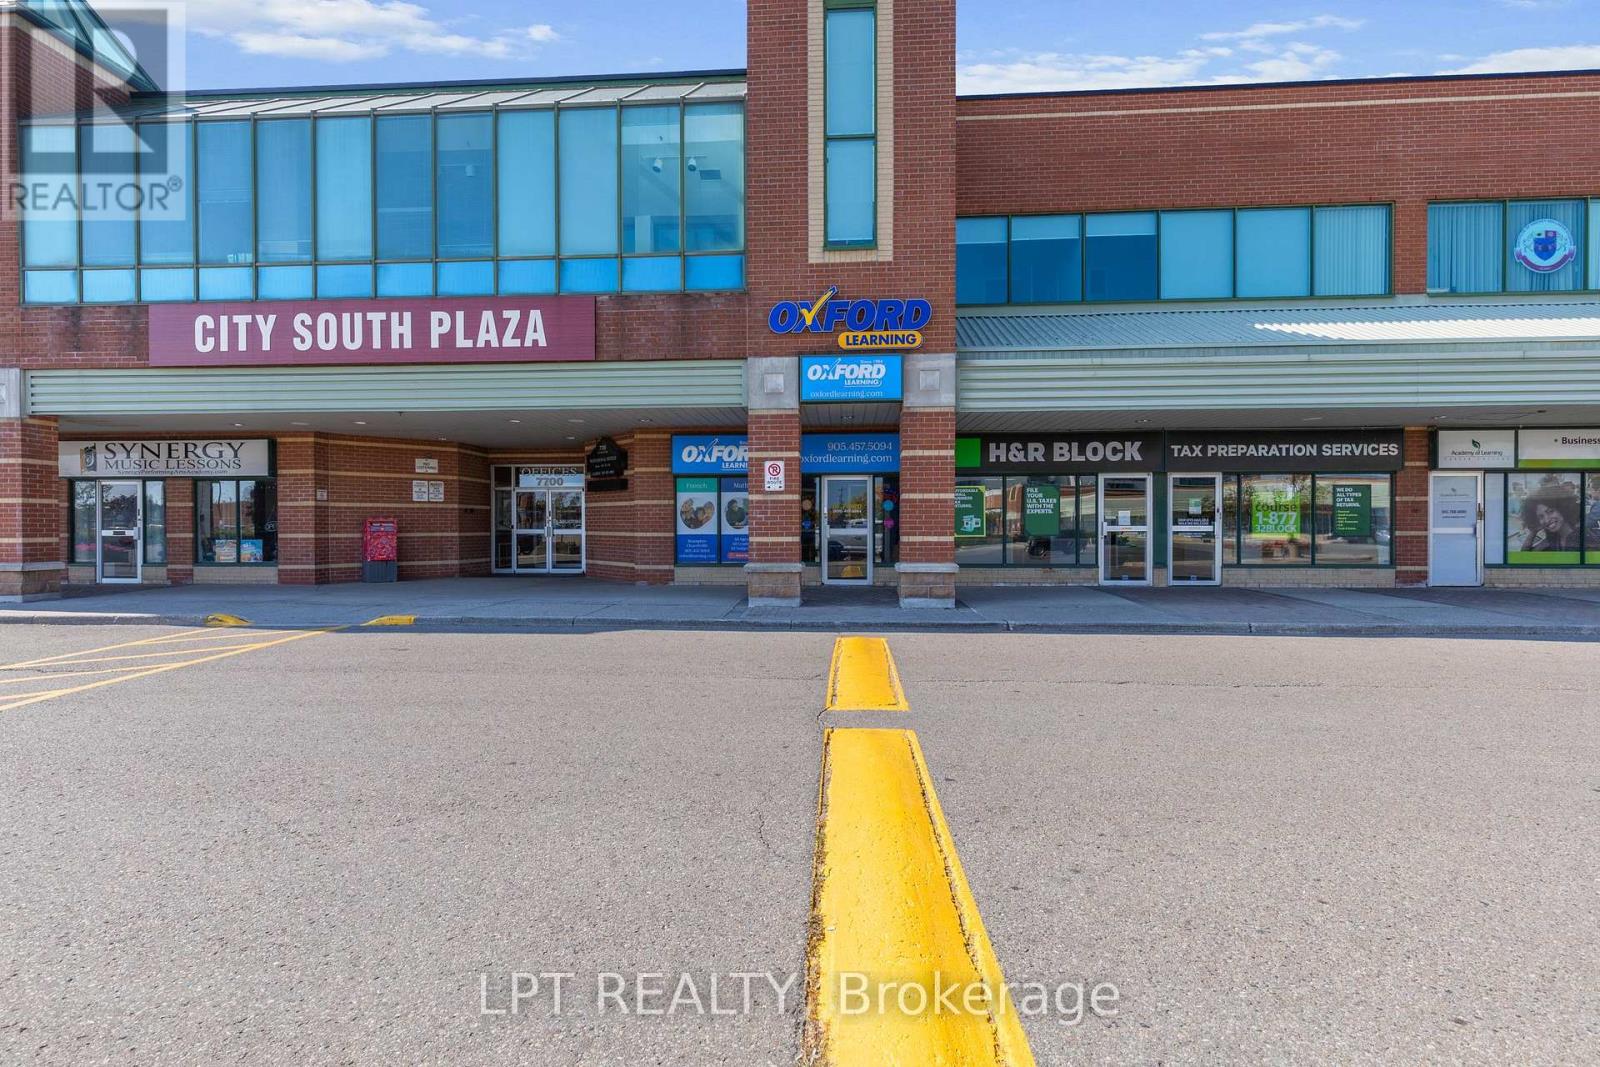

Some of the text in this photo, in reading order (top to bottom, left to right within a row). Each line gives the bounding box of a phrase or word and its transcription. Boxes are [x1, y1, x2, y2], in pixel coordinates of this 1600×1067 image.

[768, 288, 933, 334] OXFORD
[194, 309, 548, 353] CITY SOUTH PLAZA
[845, 333, 917, 347] LEARNING
[807, 361, 887, 381] OXFORD
[810, 390, 883, 399] oxfordlearning.com
[103, 442, 245, 460] SYNERGY
[827, 441, 893, 451] 905.457.5094
[988, 441, 1142, 463] H&R BLOCK
[1171, 443, 1399, 457] TAX PREPARATION SERVICES
[1451, 449, 1473, 457] Academy
[1481, 449, 1503, 457] Learning
[104, 458, 242, 470] MUSIC LESSONS
[521, 467, 577, 476] OFFICES
[536, 477, 564, 486] 7700
[1255, 503, 1297, 513] course
[1255, 511, 1298, 525] 1-877
